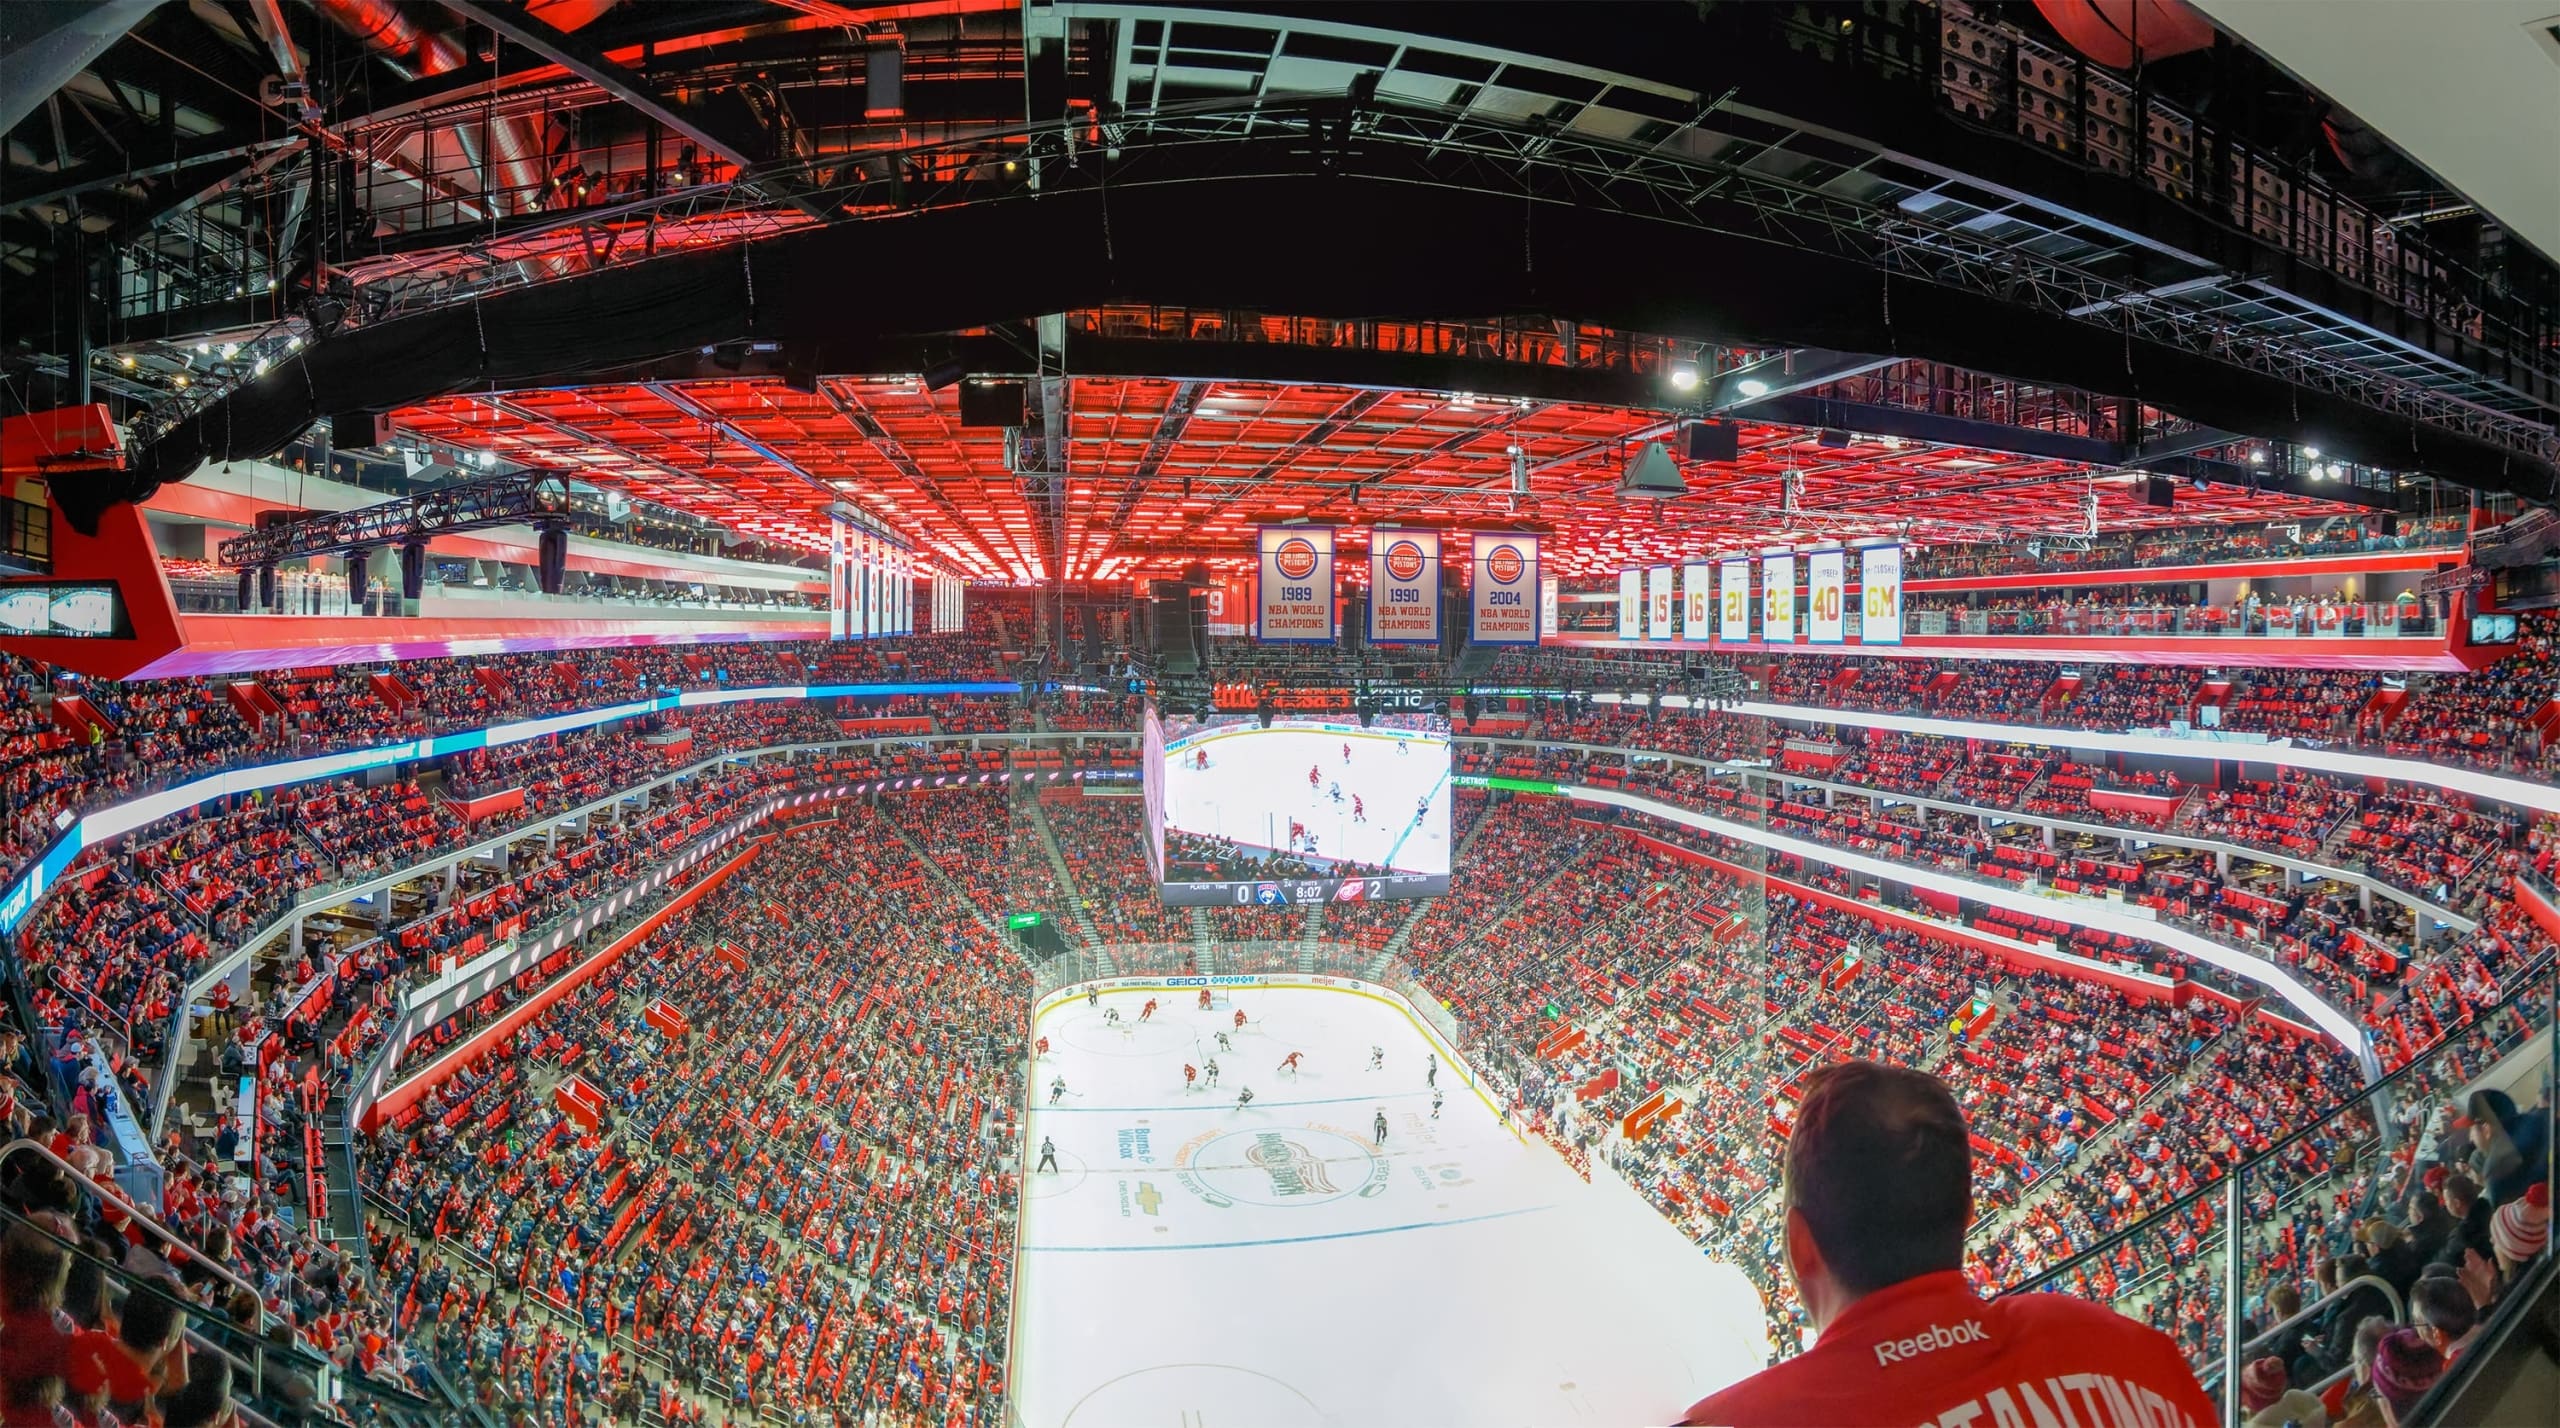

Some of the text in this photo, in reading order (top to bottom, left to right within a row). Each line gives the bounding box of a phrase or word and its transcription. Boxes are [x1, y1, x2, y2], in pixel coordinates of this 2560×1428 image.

[1281, 586, 1312, 601] 1989
[1390, 588, 1420, 603] 1990
[1489, 591, 1521, 605] 2004
[1867, 585, 1896, 617] GM
[1209, 590, 1225, 616] 9
[1268, 605, 1325, 615] NBA WORLD
[1625, 596, 1634, 622] 11
[1654, 594, 1668, 622] 15
[1688, 592, 1704, 622] 16
[1726, 591, 1743, 622] 21
[1766, 588, 1789, 621] 32
[1813, 585, 1839, 621] 40
[1378, 607, 1431, 616] NBA WORLD
[1480, 608, 1530, 618] NBA WORLD
[1268, 619, 1324, 629] CHAMPIONS
[1378, 620, 1431, 630] CHAMPIONS
[1480, 622, 1530, 632] CHAMPIONS
[1450, 776, 1460, 784] OF
[1237, 885, 1249, 903] 0
[1296, 887, 1322, 898] 8:07
[1370, 881, 1381, 899] 2
[1166, 977, 1208, 987] GEICO
[1311, 977, 1337, 986] meijer
[1117, 1128, 1134, 1160] Wilcox
[1134, 1128, 1151, 1155] Burns
[1872, 1317, 1990, 1368] Reebok
